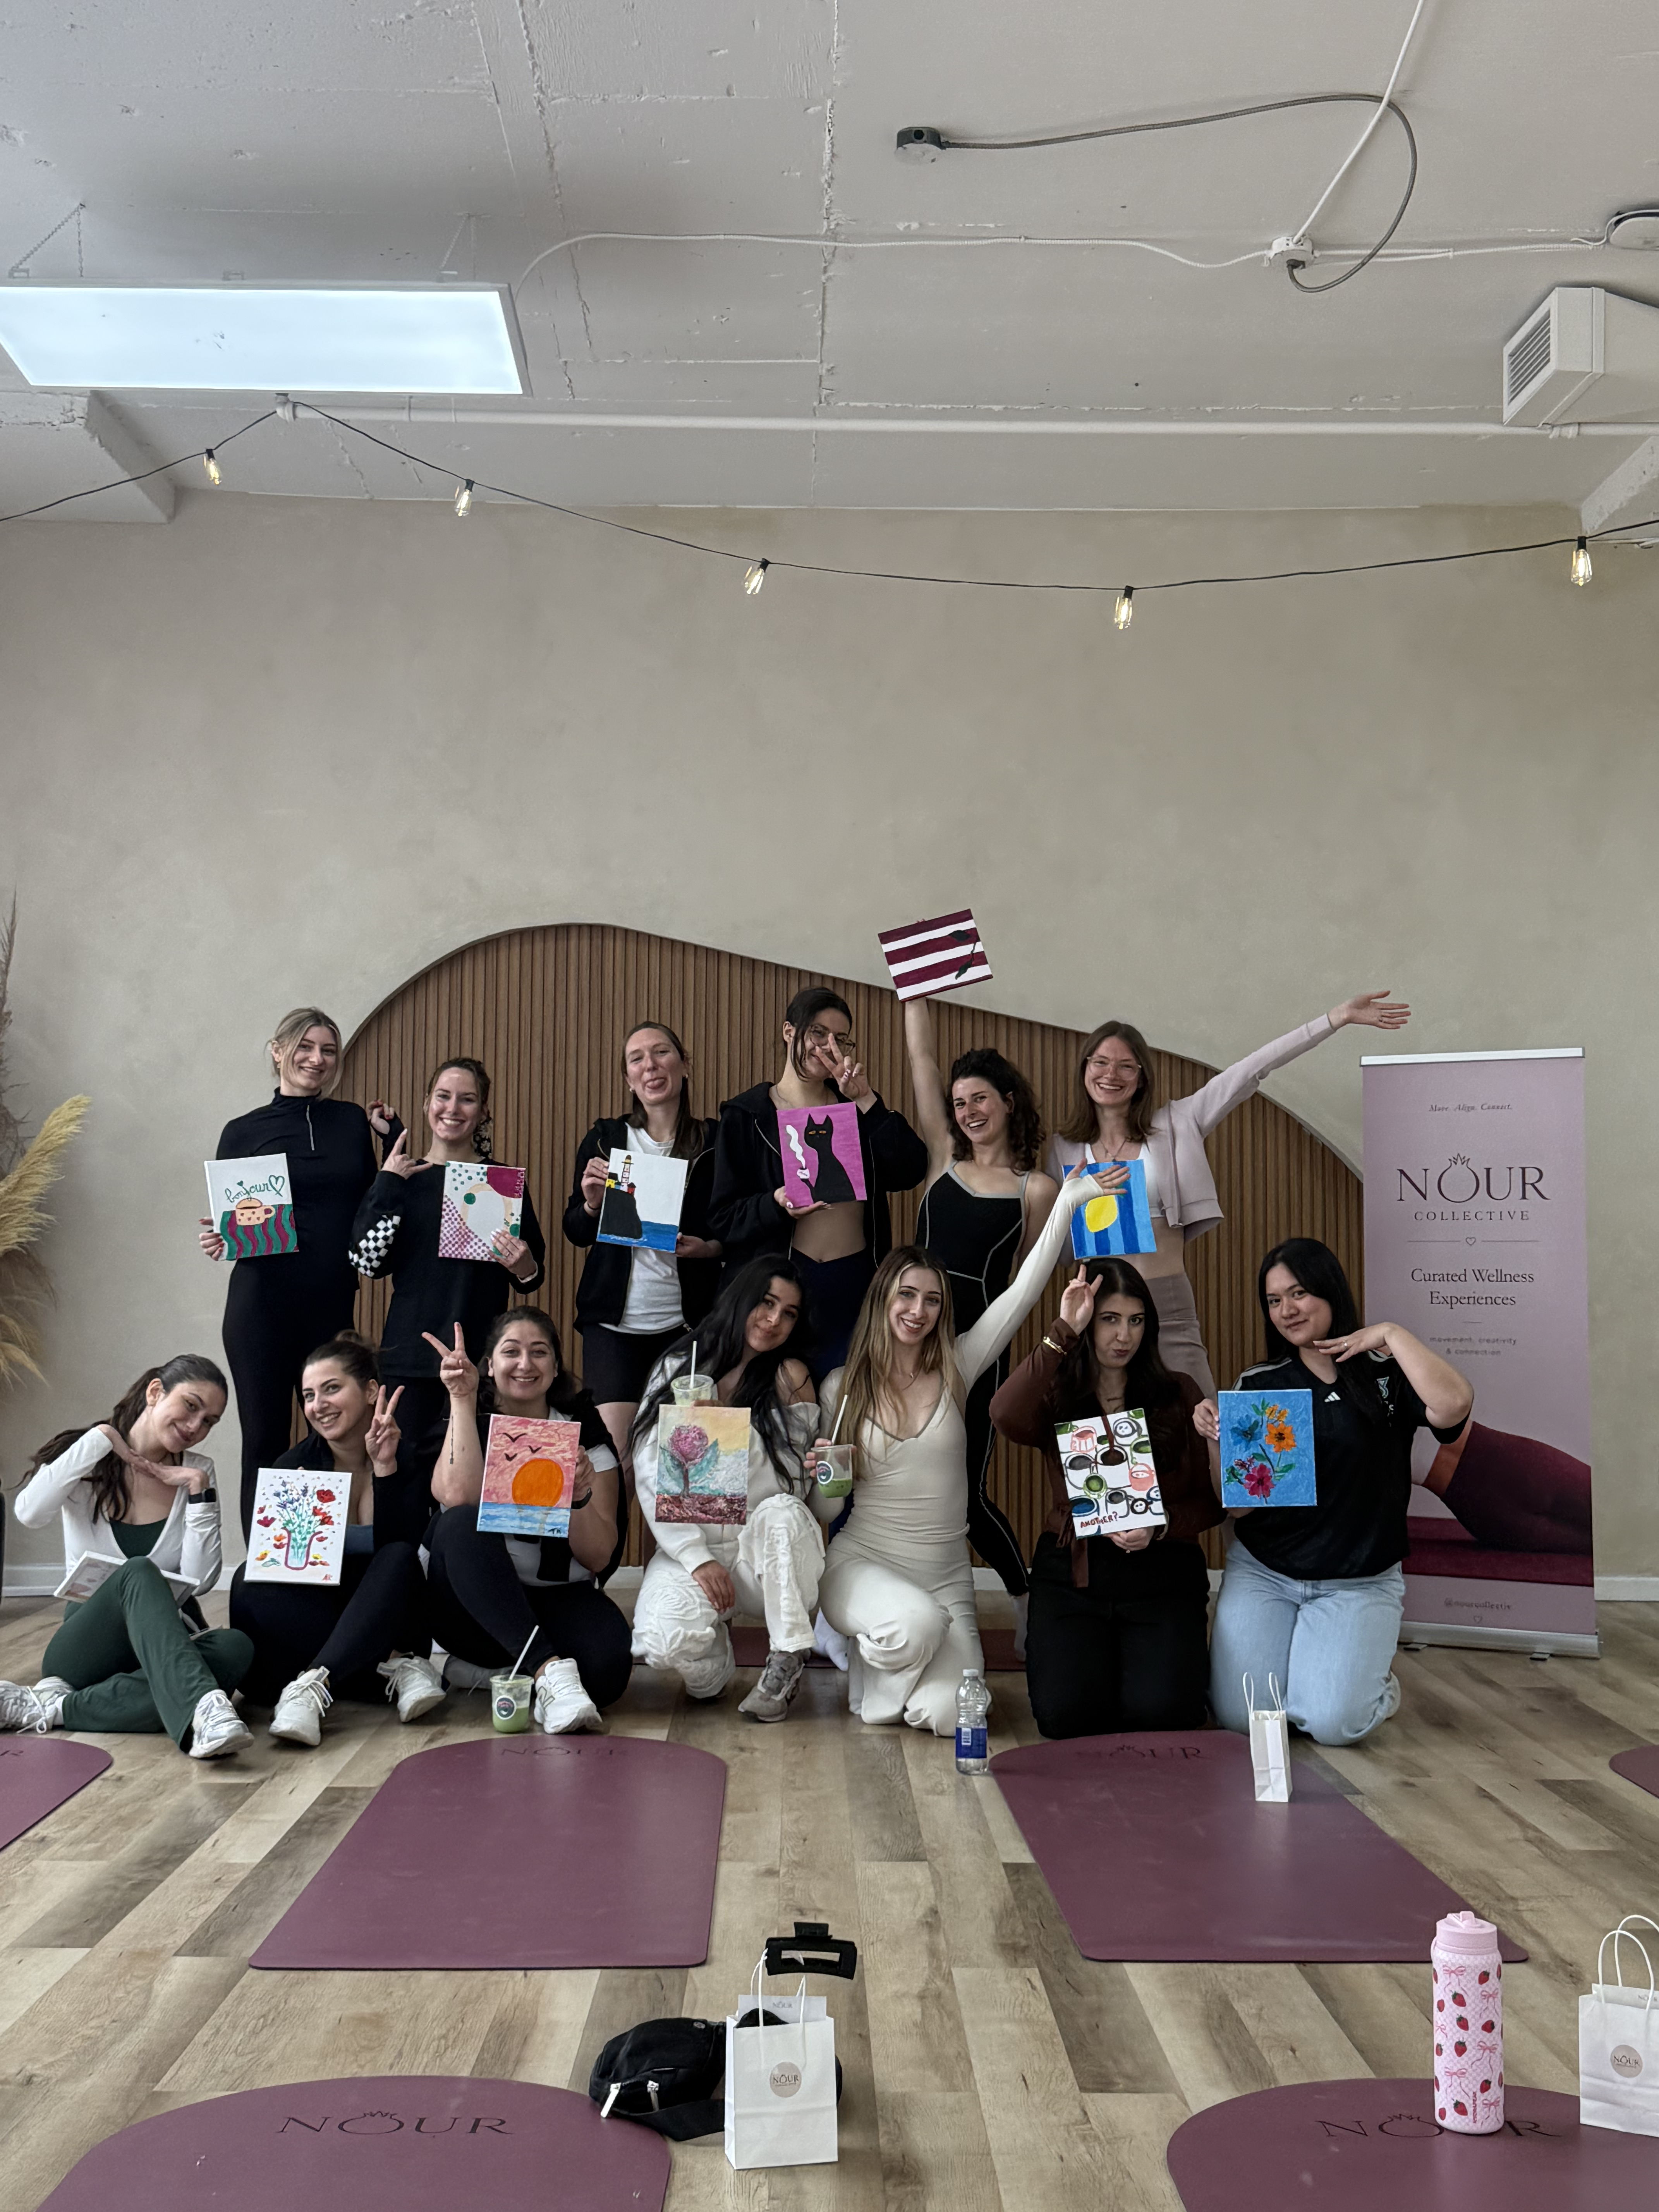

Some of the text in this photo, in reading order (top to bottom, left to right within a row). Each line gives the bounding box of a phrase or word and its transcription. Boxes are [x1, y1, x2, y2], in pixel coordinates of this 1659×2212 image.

[1397, 1153, 1551, 1203] NOUR
[225, 1180, 272, 1203] bonjour
[1414, 1210, 1529, 1221] COLLECTIVE
[1411, 1268, 1534, 1283] Curated Wellness
[1430, 1291, 1516, 1310] Experiences
[276, 2111, 514, 2135] NOUR
[1314, 2113, 1562, 2138] NOR
